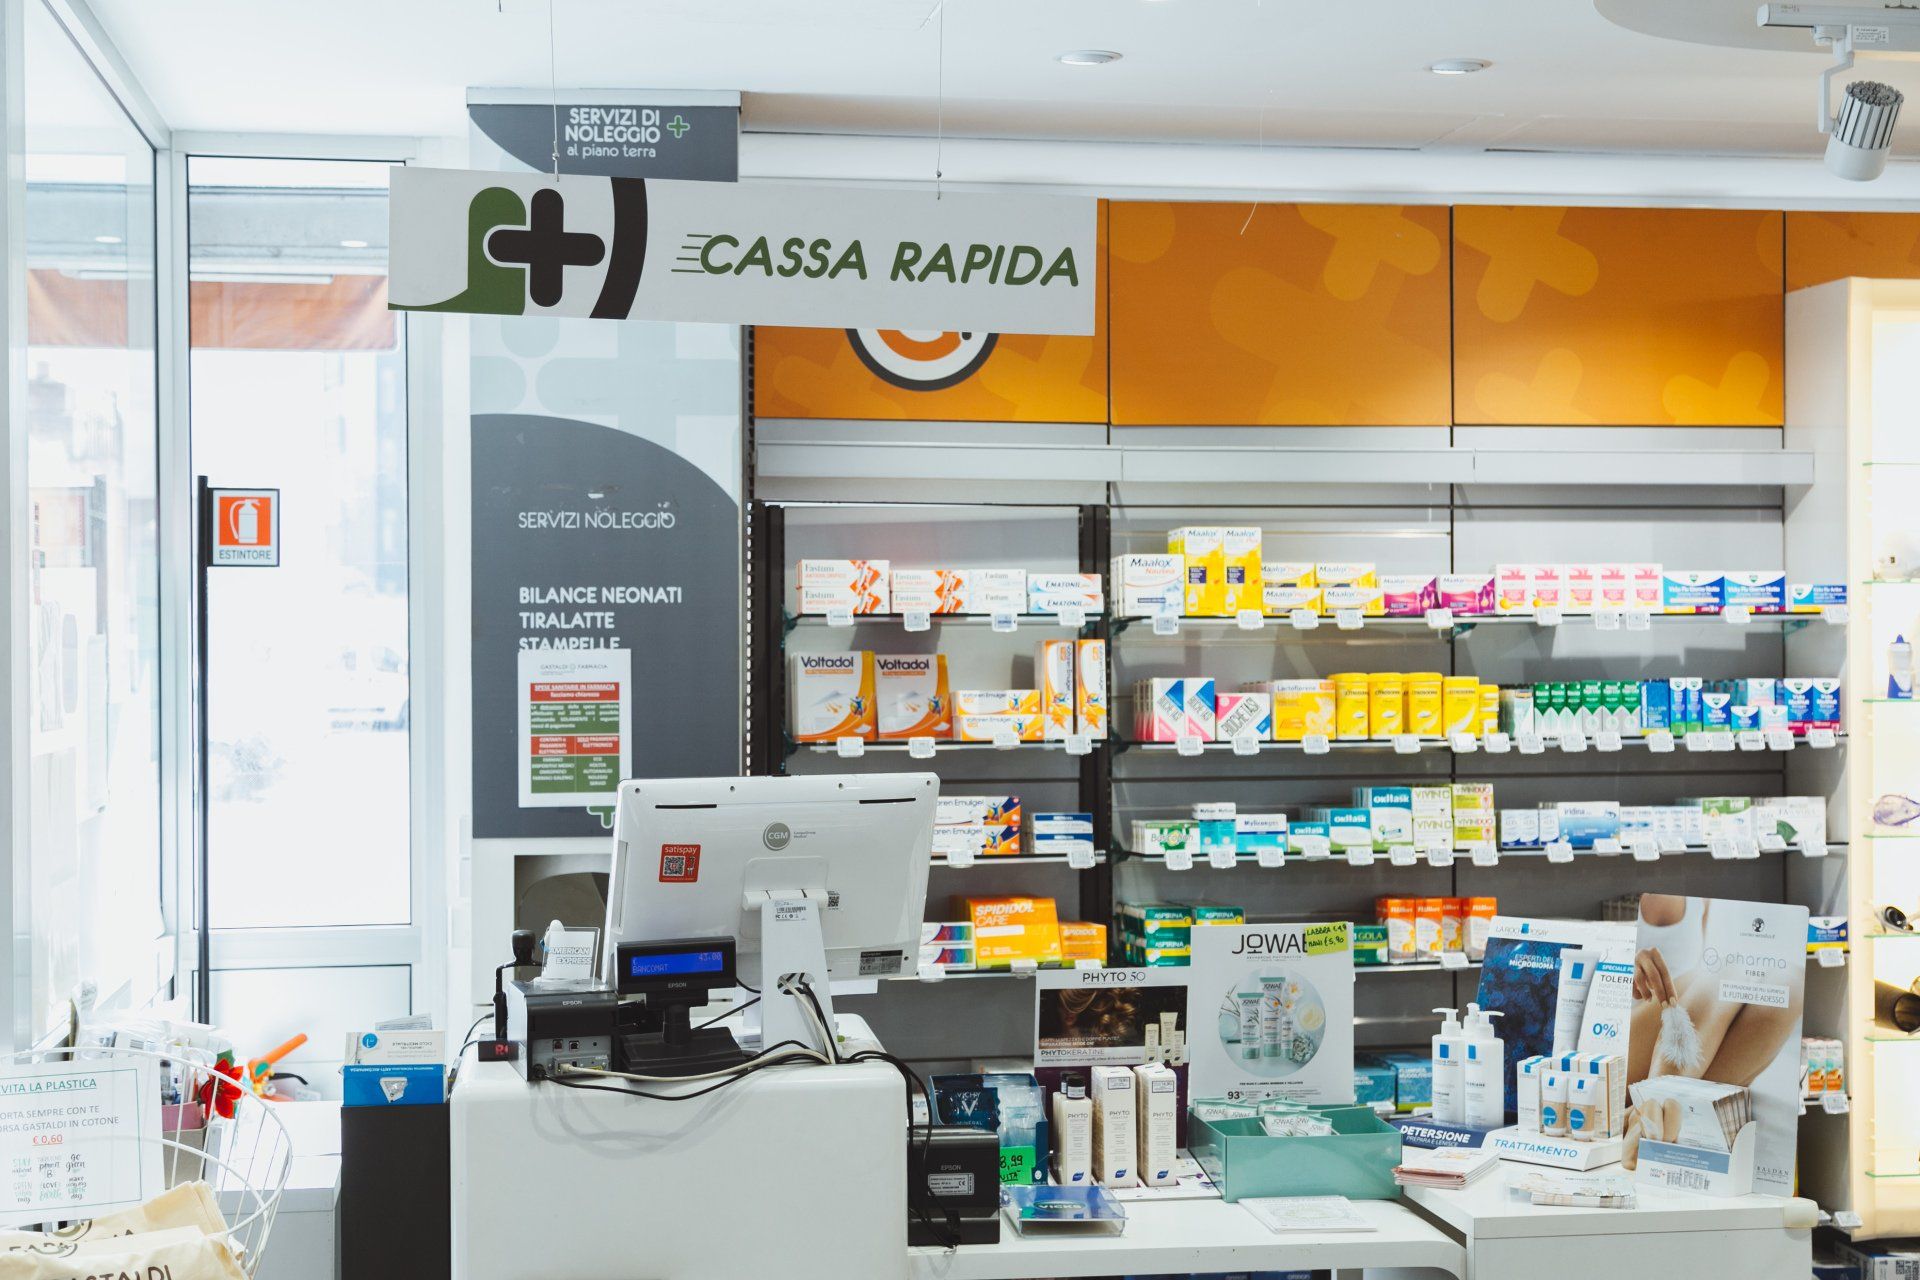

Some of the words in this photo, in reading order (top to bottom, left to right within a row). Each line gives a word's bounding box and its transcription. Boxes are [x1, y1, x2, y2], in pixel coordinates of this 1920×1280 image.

[569, 107, 637, 125] SERVIZI
[640, 108, 660, 126] DI
[565, 125, 660, 144] NOLEGGIO
[566, 144, 580, 157] al
[582, 144, 619, 159] piano
[622, 144, 656, 158] terra
[699, 233, 868, 281] CASSA
[889, 240, 1080, 288] RAPIDA
[518, 511, 580, 529] SERVIZI
[584, 511, 676, 529] NOLEGGIO
[218, 550, 272, 560] ESTINTORE
[805, 563, 835, 571] Fastum
[1130, 558, 1173, 568] Maalox
[518, 586, 598, 604] BILANCE
[601, 586, 683, 604] NEONATI
[805, 591, 835, 599] Fastum
[518, 611, 615, 629] TIRALATTE
[518, 636, 621, 650] STAMPELLE
[801, 656, 854, 668] Voltadol
[877, 659, 930, 670] Voltadol
[1415, 790, 1441, 800] VIVIN
[954, 799, 984, 808] Emulgel
[1564, 807, 1586, 816] iridina
[1416, 820, 1442, 830] VIVIN
[767, 832, 790, 840] CGM
[953, 828, 983, 837] Emulgel
[664, 845, 698, 856] satispay
[975, 901, 1035, 917] SPIDIDOL
[975, 915, 1009, 927] CARE
[550, 947, 592, 955] AMERICAN
[555, 957, 593, 965] EXPRESS
[1508, 959, 1554, 970] MICROBIOMA
[1543, 956, 1554, 964] DEL
[1602, 964, 1626, 972] SPECIALE
[1745, 969, 1766, 977] FIBER
[1082, 971, 1127, 983] PHYTO
[1129, 971, 1146, 982] 50
[1601, 975, 1634, 984] TOLERI
[1729, 992, 1754, 1000] FUTURO
[1760, 995, 1785, 1004] ADESSO
[1592, 1022, 1616, 1037] 0%
[1041, 1048, 1104, 1056] PHYTOKERATINE
[0, 1083, 26, 1094] VITA
[29, 1082, 43, 1092] LA
[46, 1078, 97, 1091] PLASTICA
[0, 1110, 25, 1120] ORTA
[26, 1107, 64, 1119] SEMPRE
[66, 1106, 87, 1115] CON
[0, 1124, 21, 1134] ORSA
[22, 1121, 68, 1132] GASTALDI
[81, 1116, 120, 1127] COTONE
[41, 1134, 63, 1145] 0,60
[1400, 1124, 1472, 1144] DETERSIONE
[1406, 1135, 1431, 1144] PREPARA
[1493, 1138, 1578, 1159] TRATTAMENTO
